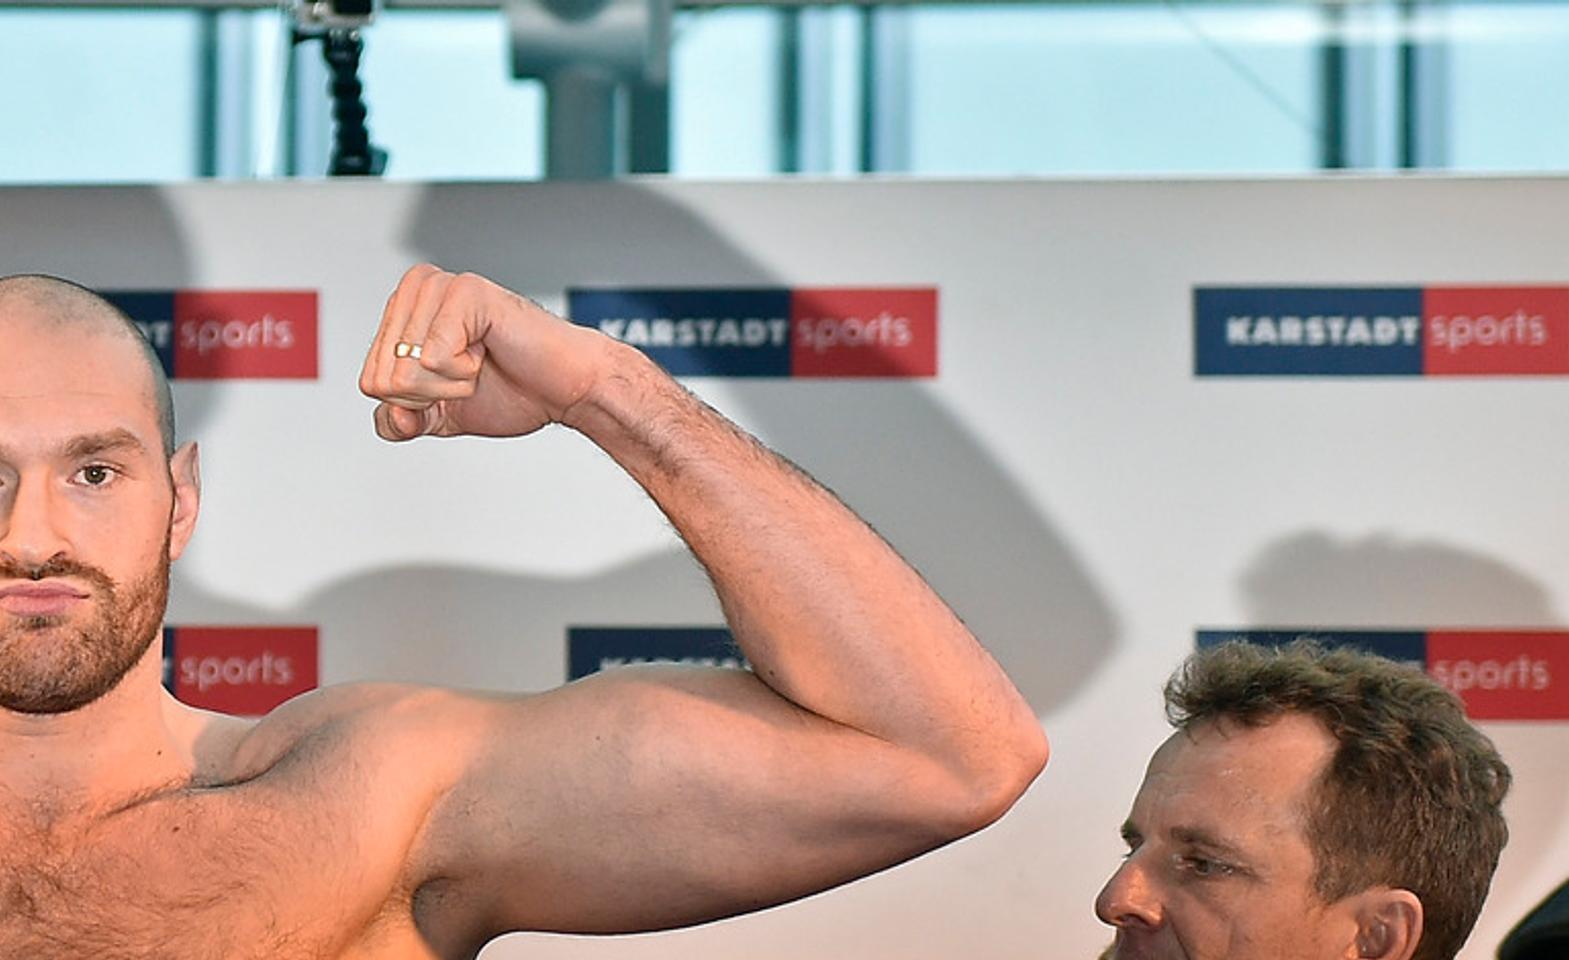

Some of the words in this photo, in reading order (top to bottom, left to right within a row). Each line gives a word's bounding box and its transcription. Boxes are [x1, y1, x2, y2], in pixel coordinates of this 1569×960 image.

[180, 313, 295, 356] sports
[797, 312, 912, 354] sports
[1226, 315, 1420, 346] KARSTADT
[1430, 309, 1547, 353] sports
[181, 651, 295, 692] sports
[1433, 654, 1551, 693] sports
